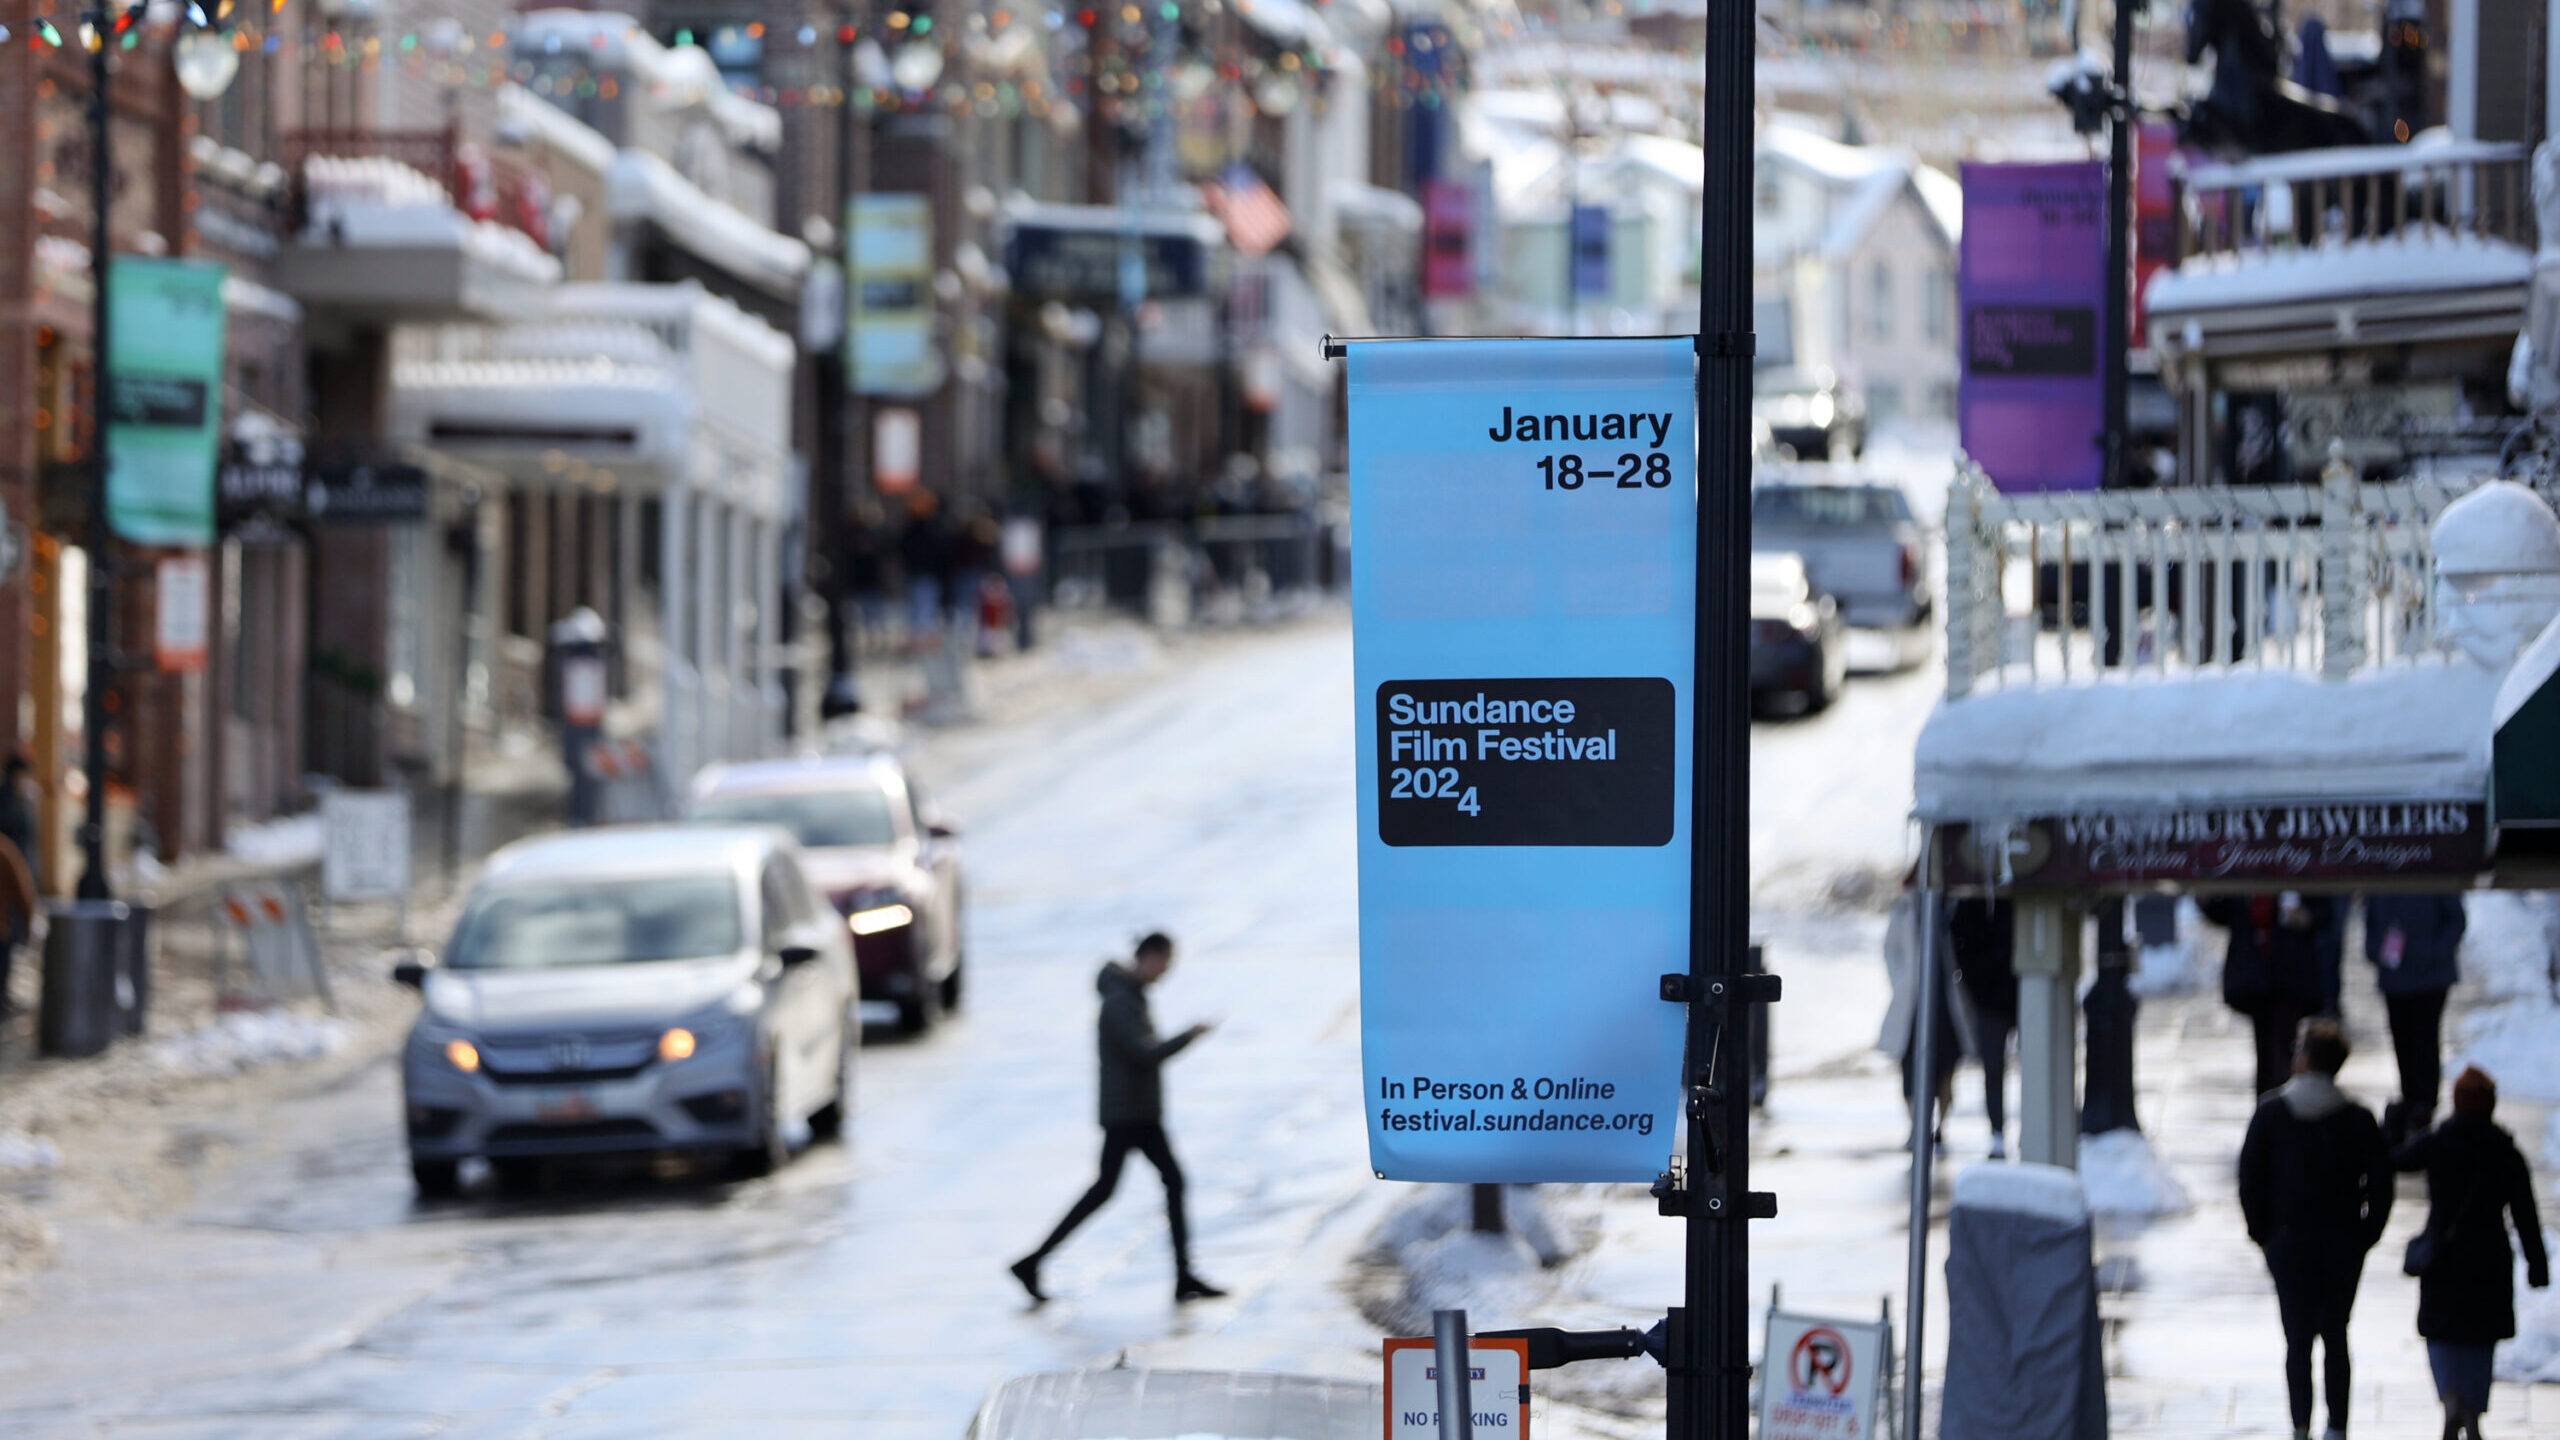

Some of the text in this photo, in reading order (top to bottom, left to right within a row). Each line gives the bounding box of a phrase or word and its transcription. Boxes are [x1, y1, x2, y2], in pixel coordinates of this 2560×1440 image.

[1489, 406, 1672, 448] January
[1536, 452, 1672, 490] 18–28
[1389, 692, 1576, 725] Sundance
[1391, 728, 1616, 762] Film Festival
[1390, 766, 1481, 817] 2024
[2277, 801, 2469, 839] JEWELERS
[1381, 1076, 1616, 1101] In Person & Online
[1380, 1108, 1654, 1136] festival.sundance.org
[1404, 1411, 1508, 1427] NO PKING
